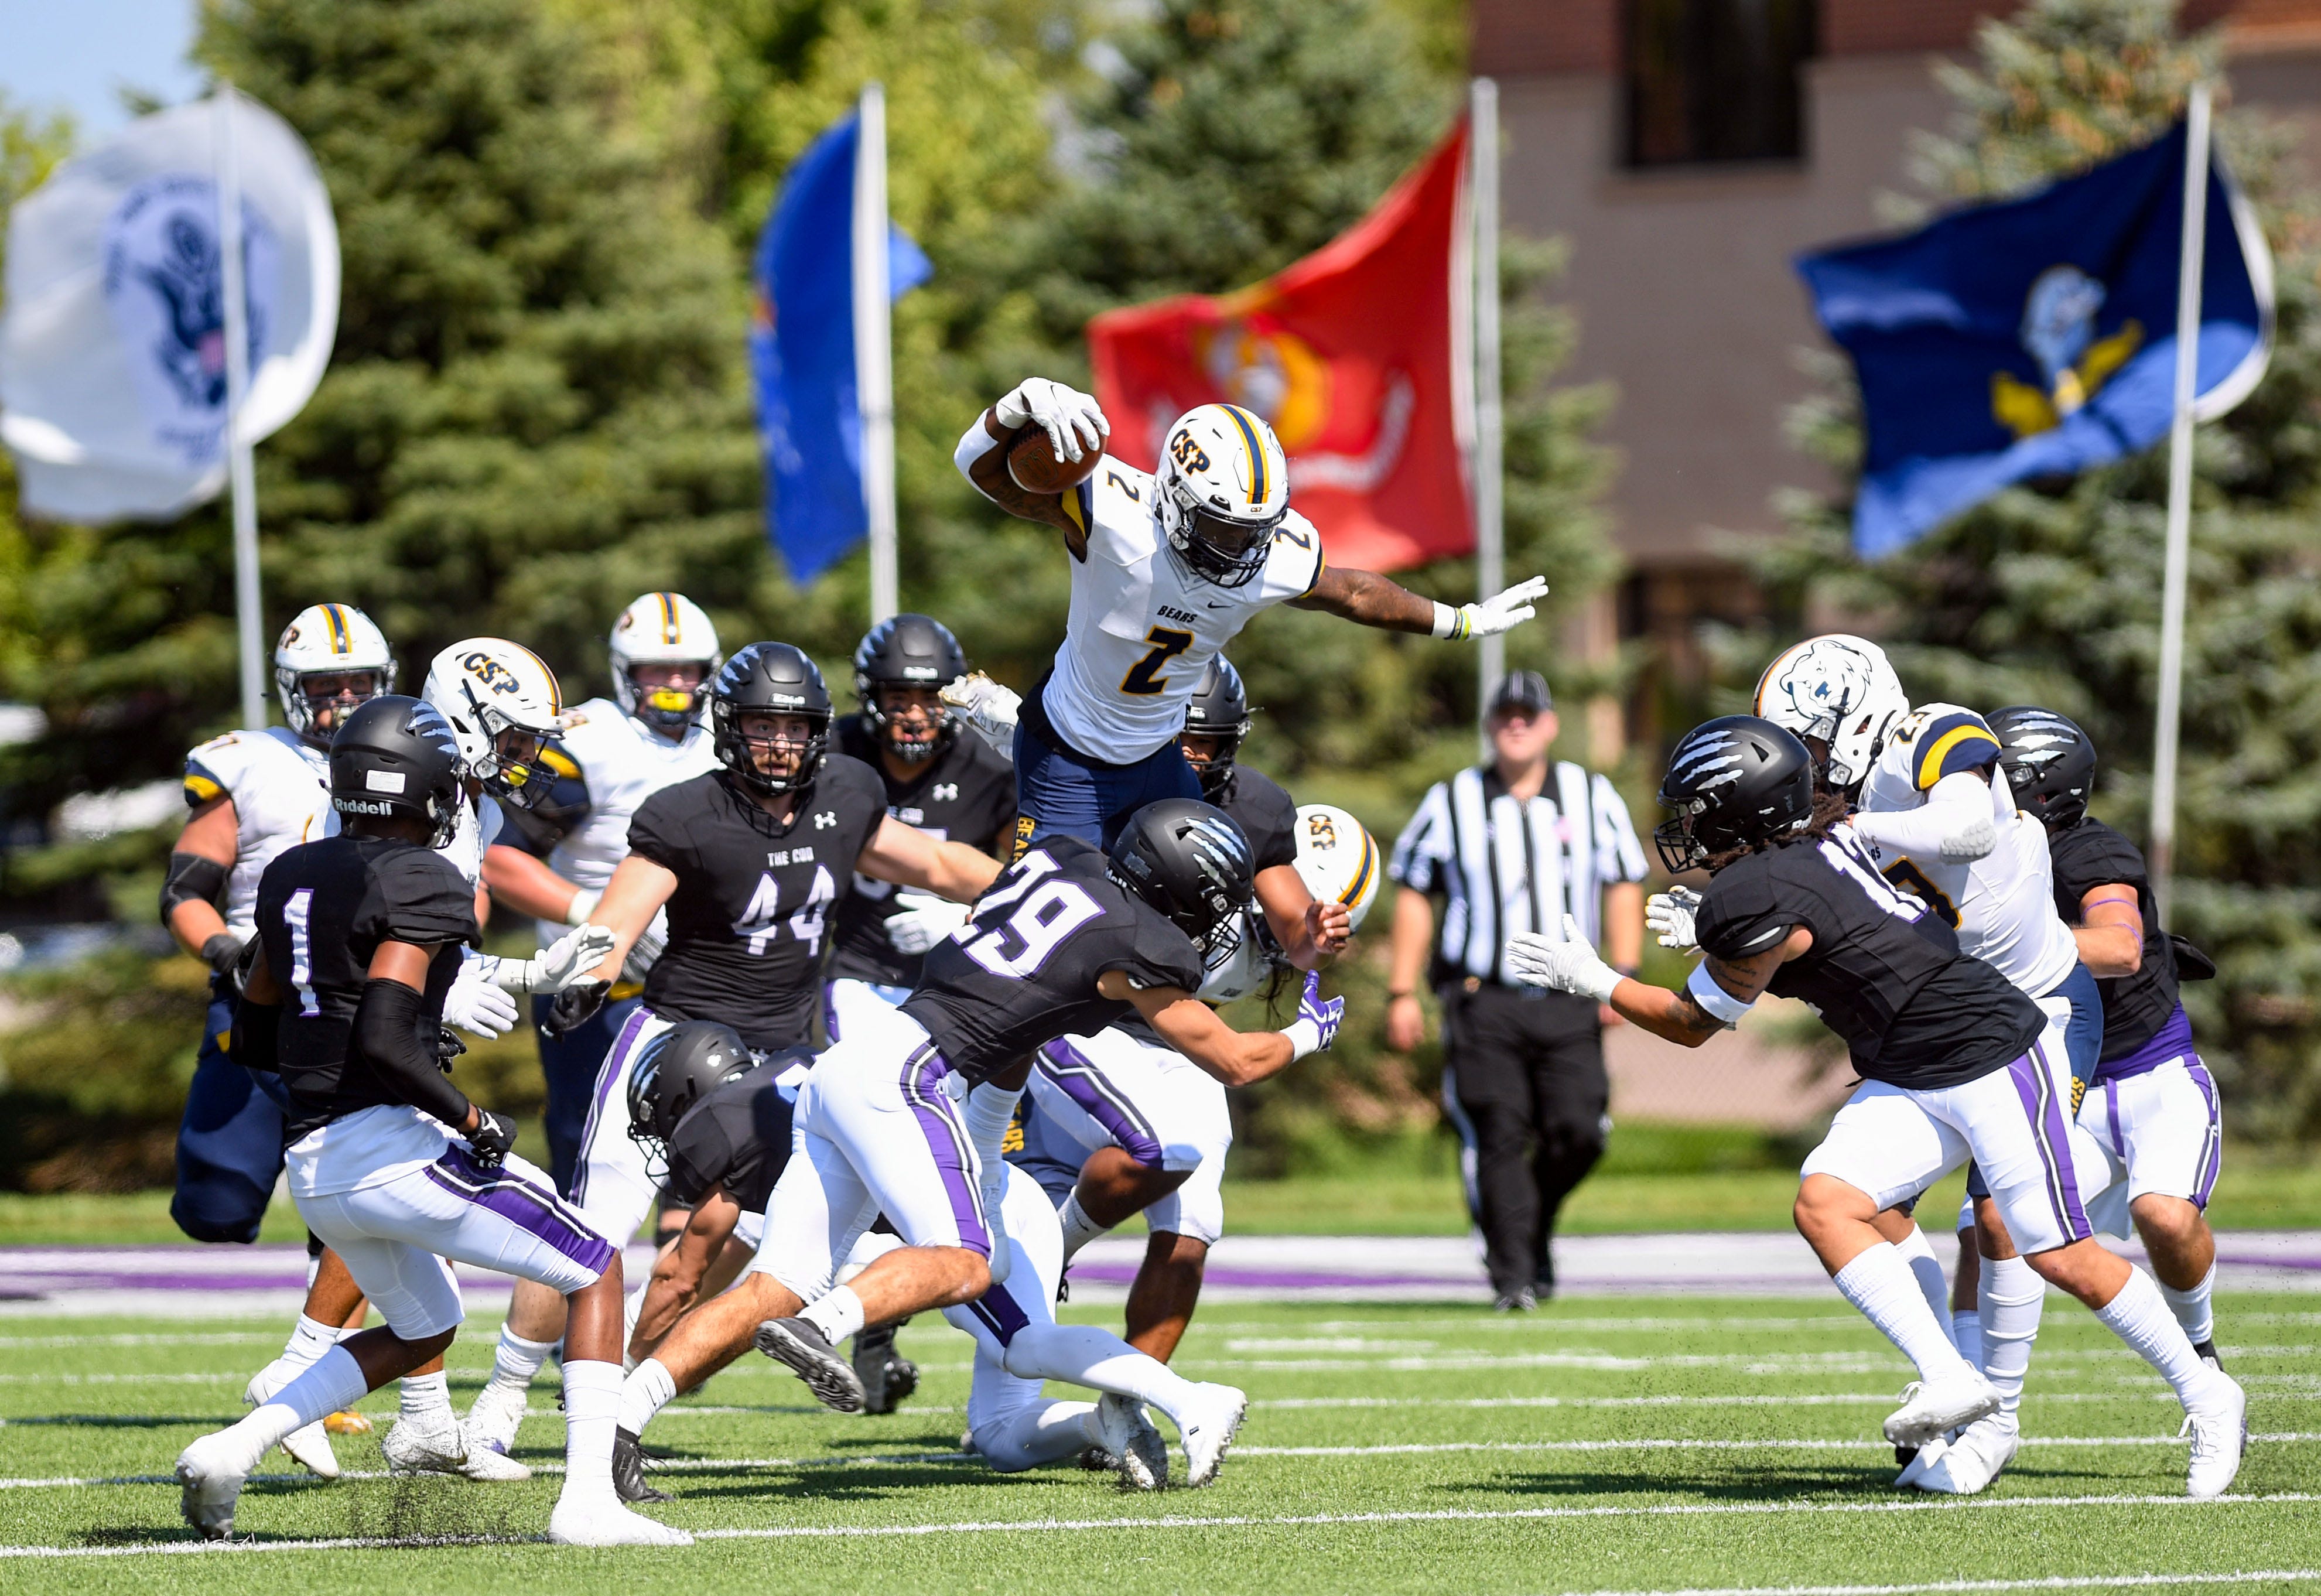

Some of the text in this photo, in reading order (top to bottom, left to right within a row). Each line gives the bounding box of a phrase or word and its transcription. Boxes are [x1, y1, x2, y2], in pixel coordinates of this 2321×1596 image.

[1170, 428, 1211, 476] CSP
[1107, 470, 1140, 503] 2
[1275, 526, 1311, 551] 2
[1157, 605, 1198, 623] BEARS
[464, 652, 520, 696] CSP
[1119, 623, 1195, 696] 2
[334, 798, 392, 816] Riddell
[1308, 814, 1336, 851] CSP
[767, 850, 789, 867] THE
[731, 863, 836, 958] 44
[282, 887, 322, 1017] 1
